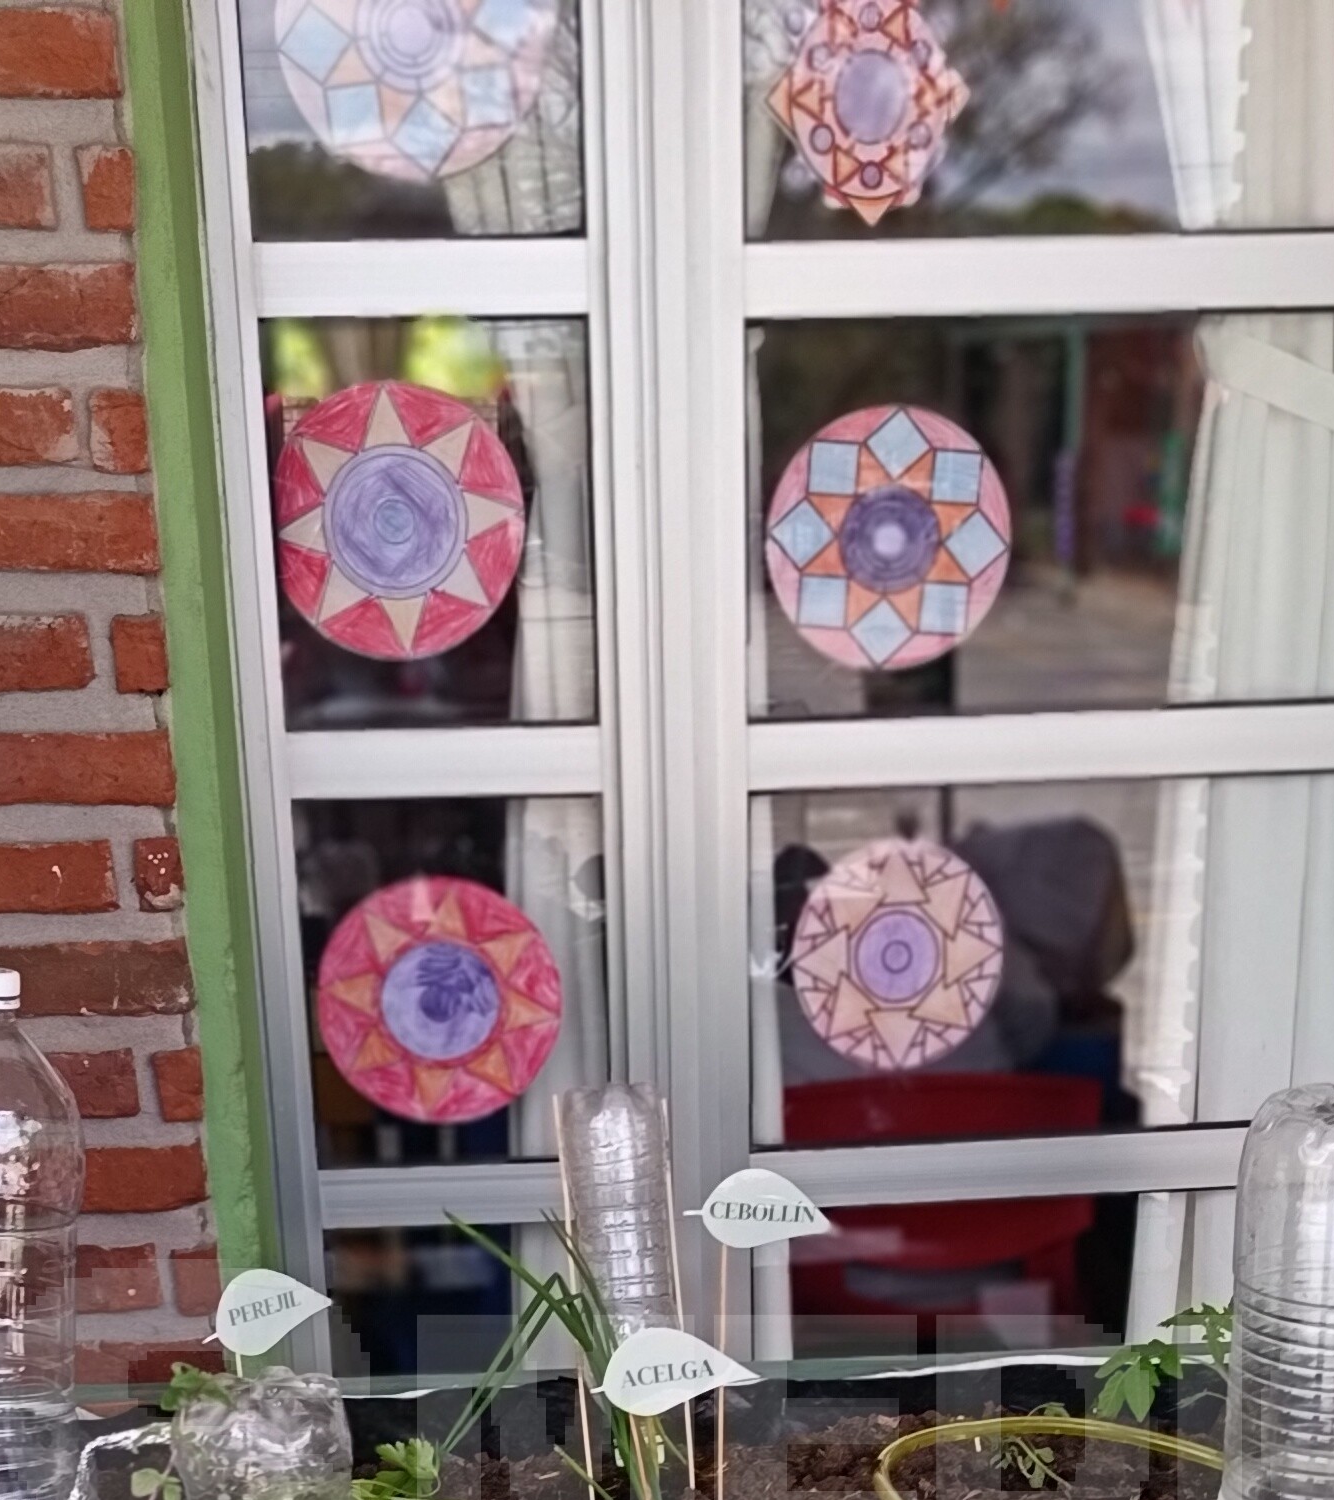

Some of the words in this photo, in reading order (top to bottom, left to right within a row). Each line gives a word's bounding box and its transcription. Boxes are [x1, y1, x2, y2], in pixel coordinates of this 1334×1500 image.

[709, 1200, 816, 1223] CEBOLLÍN
[227, 1289, 302, 1327] PEREJIL
[620, 1358, 716, 1390] ACELGA
